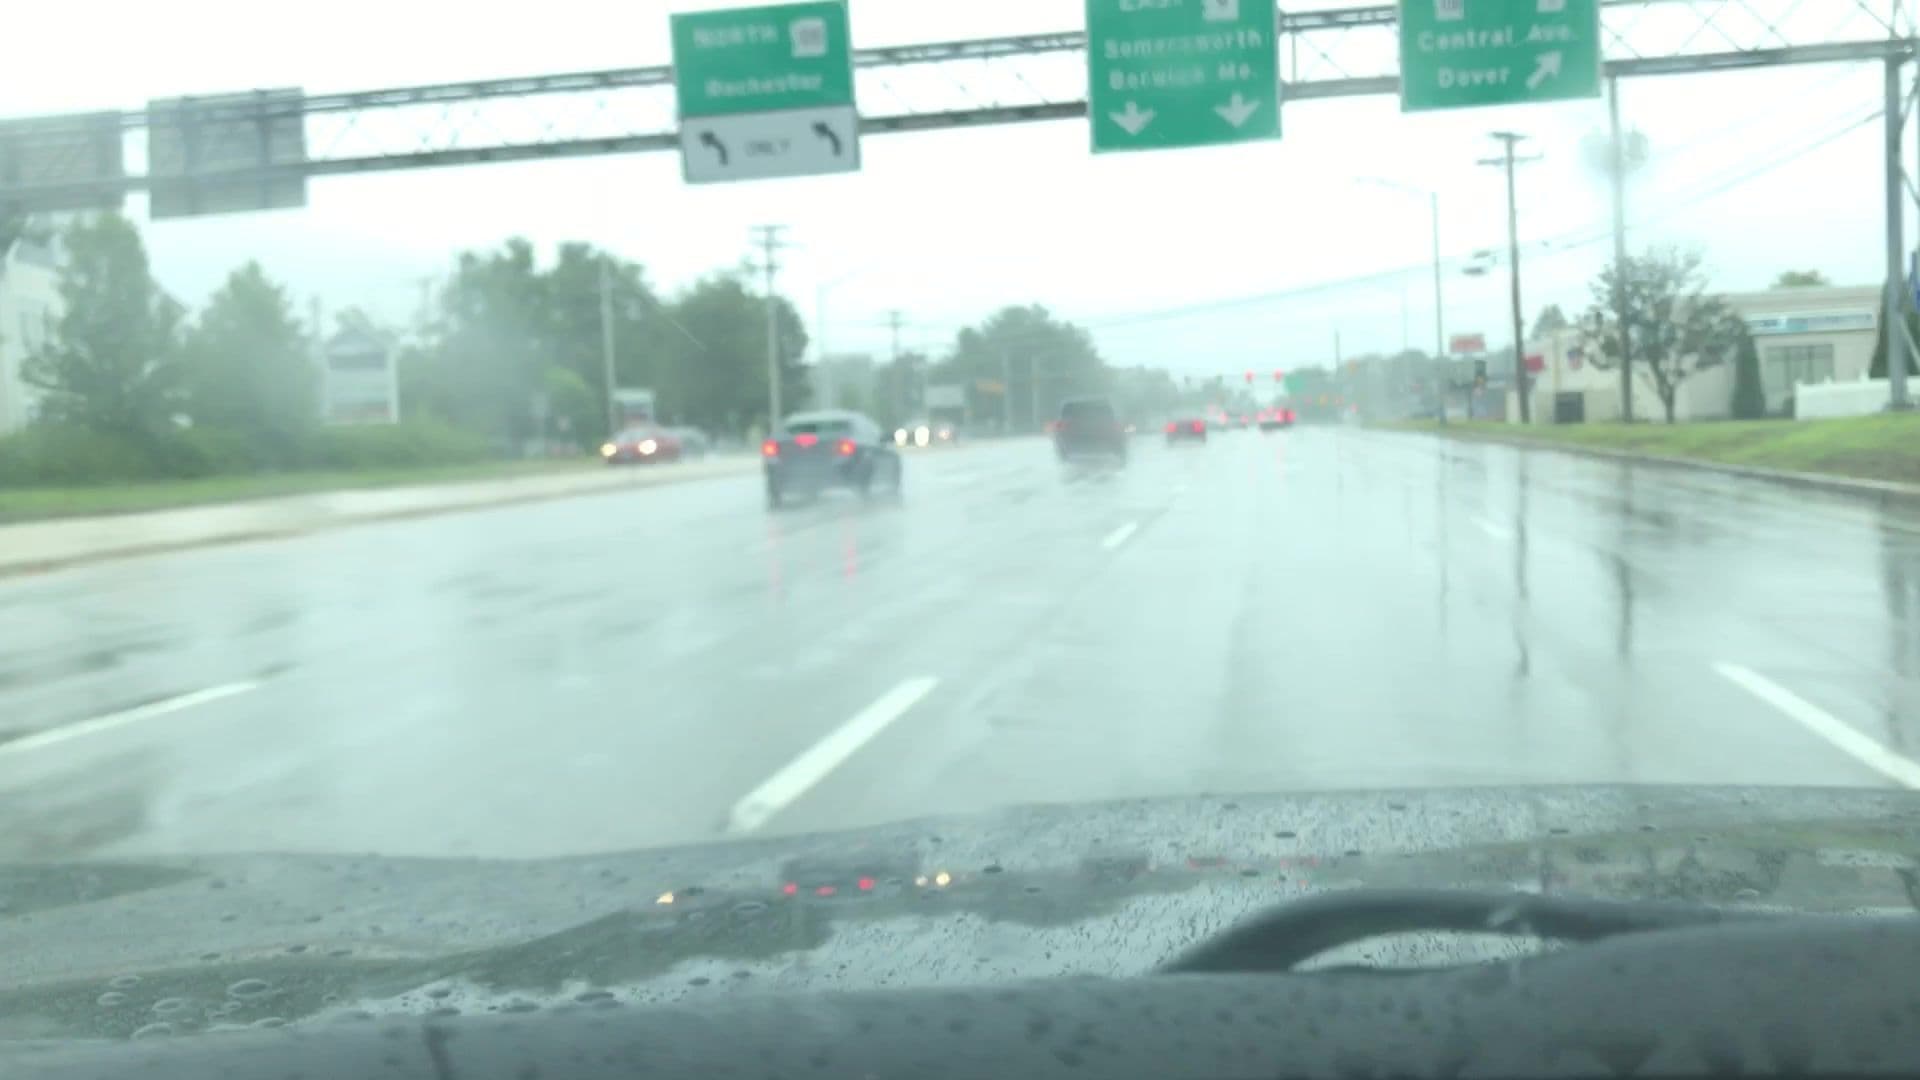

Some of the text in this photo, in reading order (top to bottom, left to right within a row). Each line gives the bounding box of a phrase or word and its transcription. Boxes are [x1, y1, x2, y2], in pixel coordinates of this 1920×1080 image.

[1105, 30, 1262, 58] Somersworth
[1418, 26, 1513, 52] Central
[1110, 68, 1205, 90] Berwick
[1439, 67, 1511, 88] Dover
